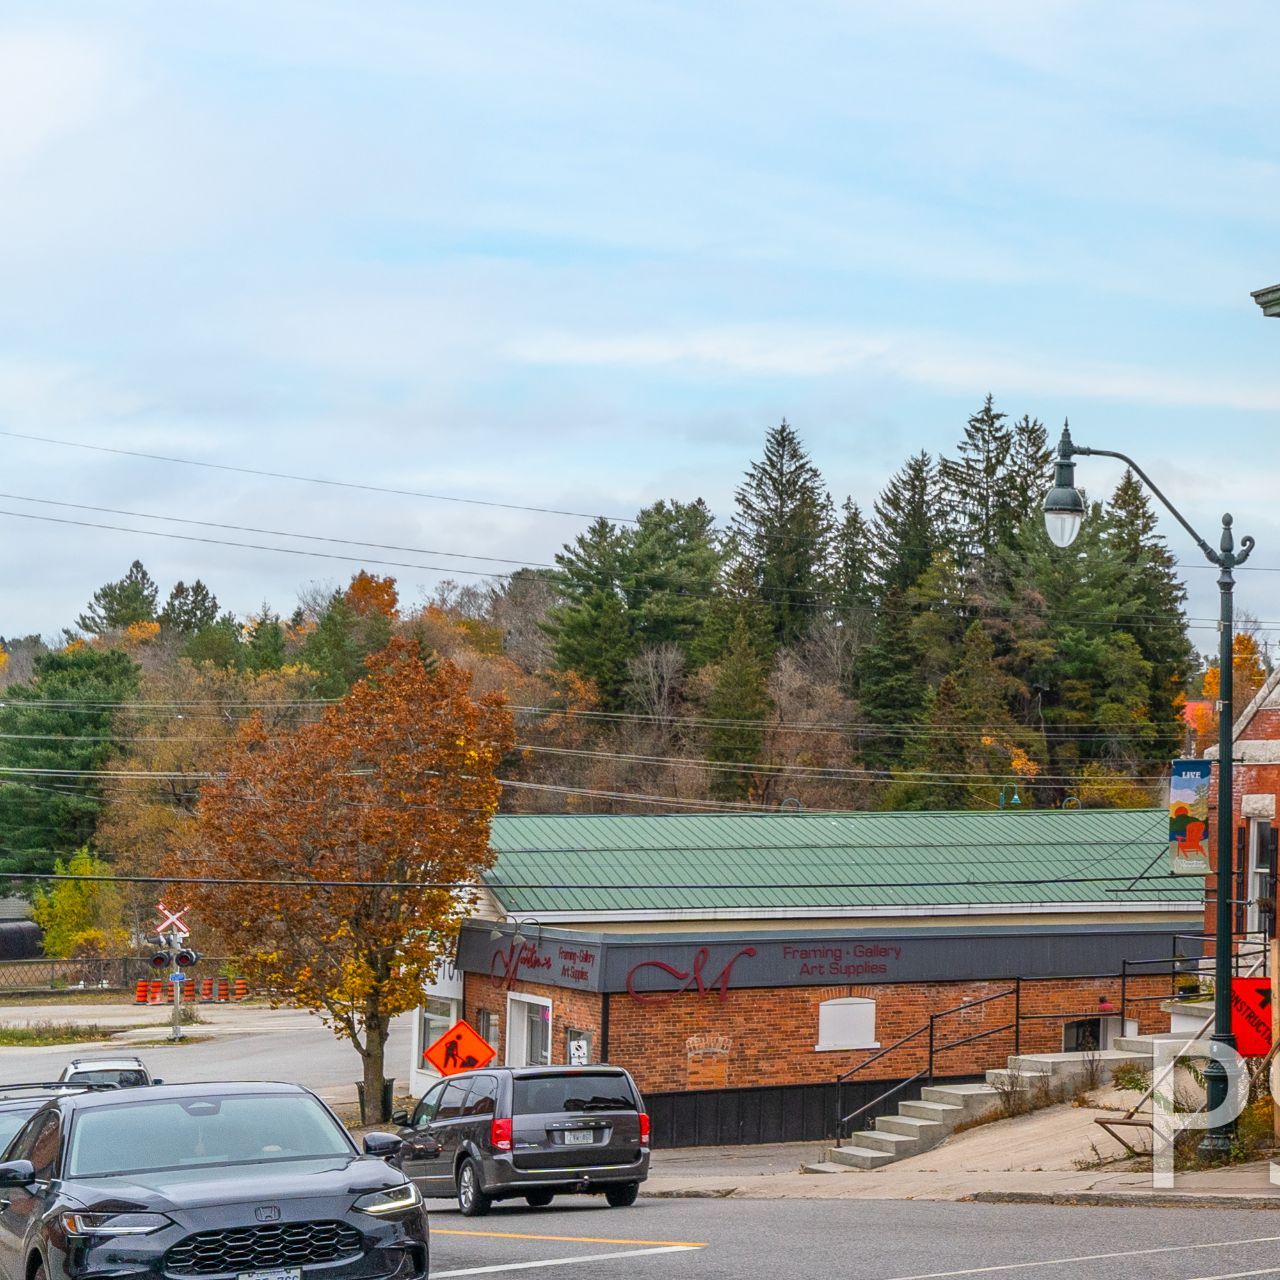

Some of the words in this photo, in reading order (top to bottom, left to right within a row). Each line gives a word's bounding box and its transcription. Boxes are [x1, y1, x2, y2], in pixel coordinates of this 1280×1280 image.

[1181, 771, 1201, 779] LIVE
[783, 946, 842, 961] Framing
[853, 944, 902, 959] Gallery
[800, 963, 825, 976] Art
[829, 961, 888, 978] Supplies
